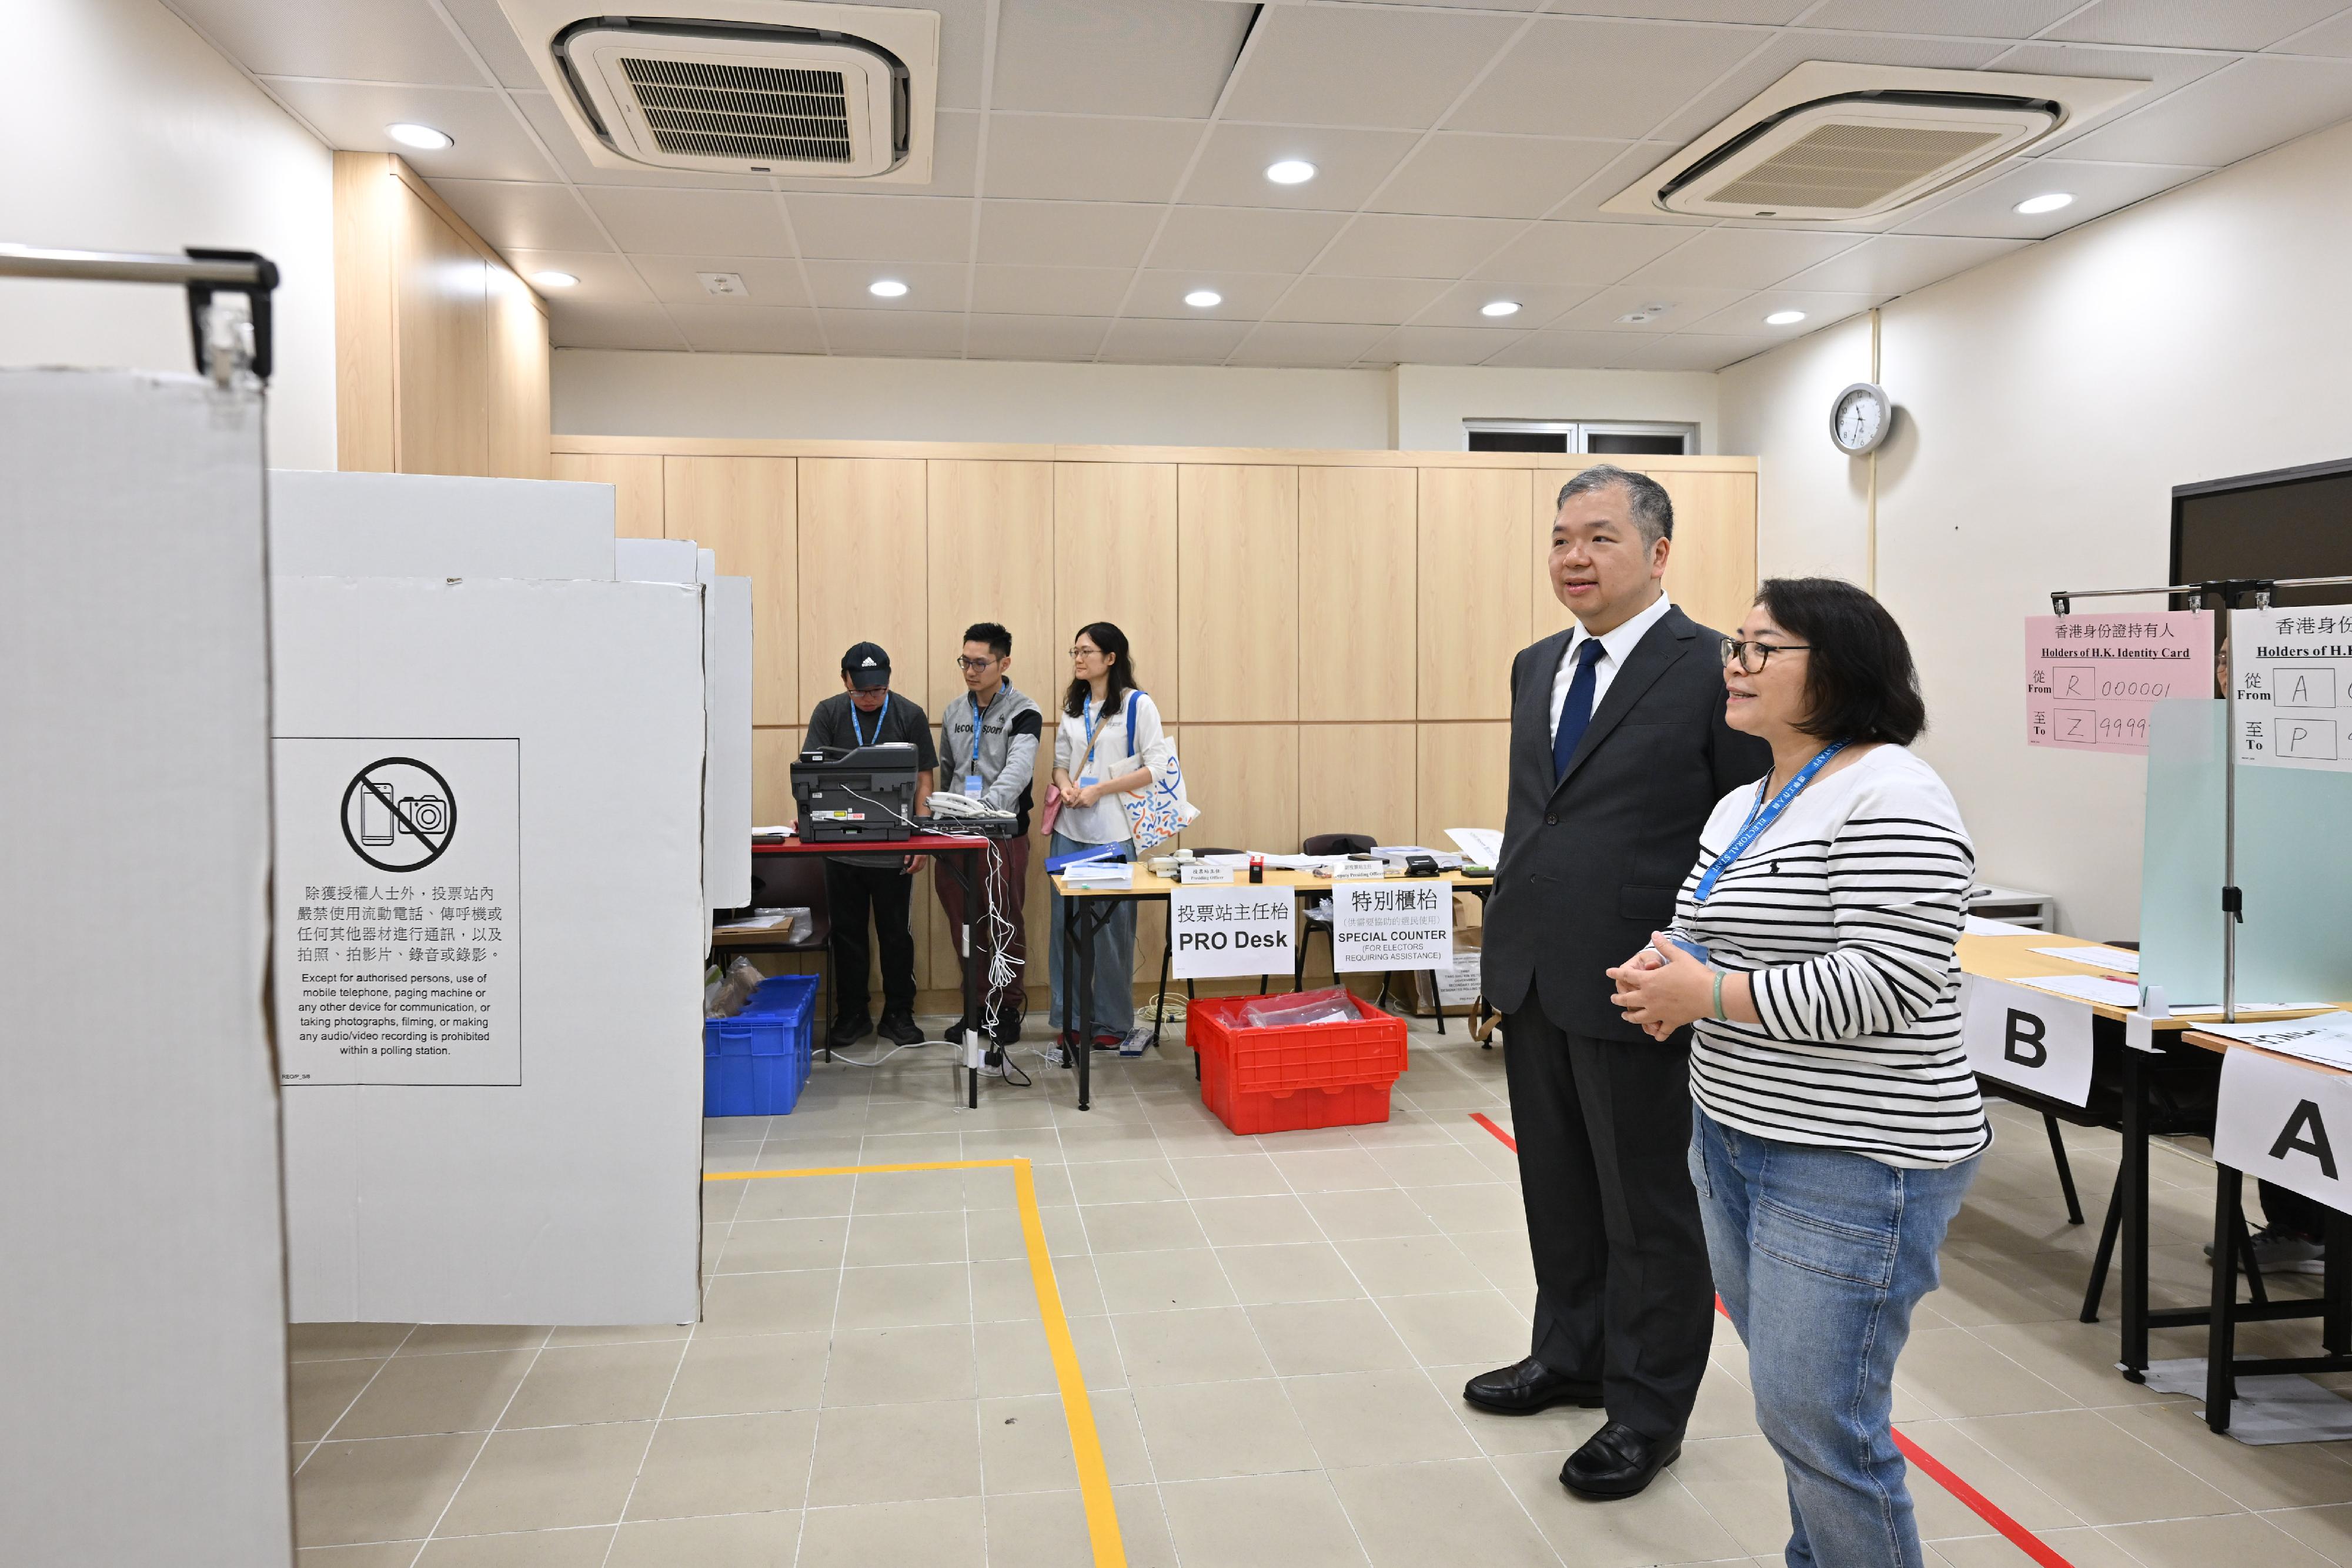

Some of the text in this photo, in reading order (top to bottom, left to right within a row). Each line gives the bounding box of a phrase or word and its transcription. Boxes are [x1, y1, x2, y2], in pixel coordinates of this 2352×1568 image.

[2055, 623, 2174, 638] 香港身份證持有人
[2042, 648, 2190, 660] Holders of H.K. Identity Card
[2257, 647, 2309, 656] Holders
[2313, 646, 2327, 656] of
[2033, 670, 2045, 684] 從
[2244, 672, 2262, 689] 從
[2028, 685, 2052, 693] From
[2066, 676, 2170, 697] R 000001
[2292, 676, 2307, 702] A
[2237, 690, 2271, 700] From
[2033, 711, 2046, 724] 至
[2033, 727, 2046, 735] To
[2067, 718, 2150, 738] Z 9999
[2246, 721, 2263, 737] 至
[2246, 740, 2263, 750] To
[2291, 727, 2307, 752] P
[1813, 748, 1834, 768] STAFF
[1729, 817, 1767, 854] ELECTORAL
[1712, 854, 1731, 873] STAFF
[1352, 888, 1437, 912] 特別櫃枱
[1178, 902, 1288, 922] 投票站主任枱
[1179, 930, 1288, 951] PRO Desk
[1338, 931, 1446, 942] SPECIAL COUNTER
[1362, 945, 1381, 953] (FOR
[302, 974, 336, 984] Except
[477, 974, 487, 982] of
[340, 988, 390, 998] telephone,
[395, 989, 427, 999] paging
[299, 1005, 316, 1013] any
[349, 1002, 380, 1011] device
[384, 1002, 397, 1011] for
[400, 1004, 476, 1012] communication,
[301, 1018, 330, 1028] taking
[335, 1018, 397, 1027] photographs,
[402, 1017, 436, 1028] filming,
[453, 1018, 487, 1028] making
[321, 1031, 378, 1040] audio/video
[382, 1032, 426, 1042] recording
[430, 1032, 437, 1040] is
[442, 1032, 489, 1042] prohibited
[2003, 1007, 2047, 1068] B
[340, 1045, 368, 1054] within
[381, 1047, 412, 1057] polling
[2267, 1098, 2339, 1181] A
